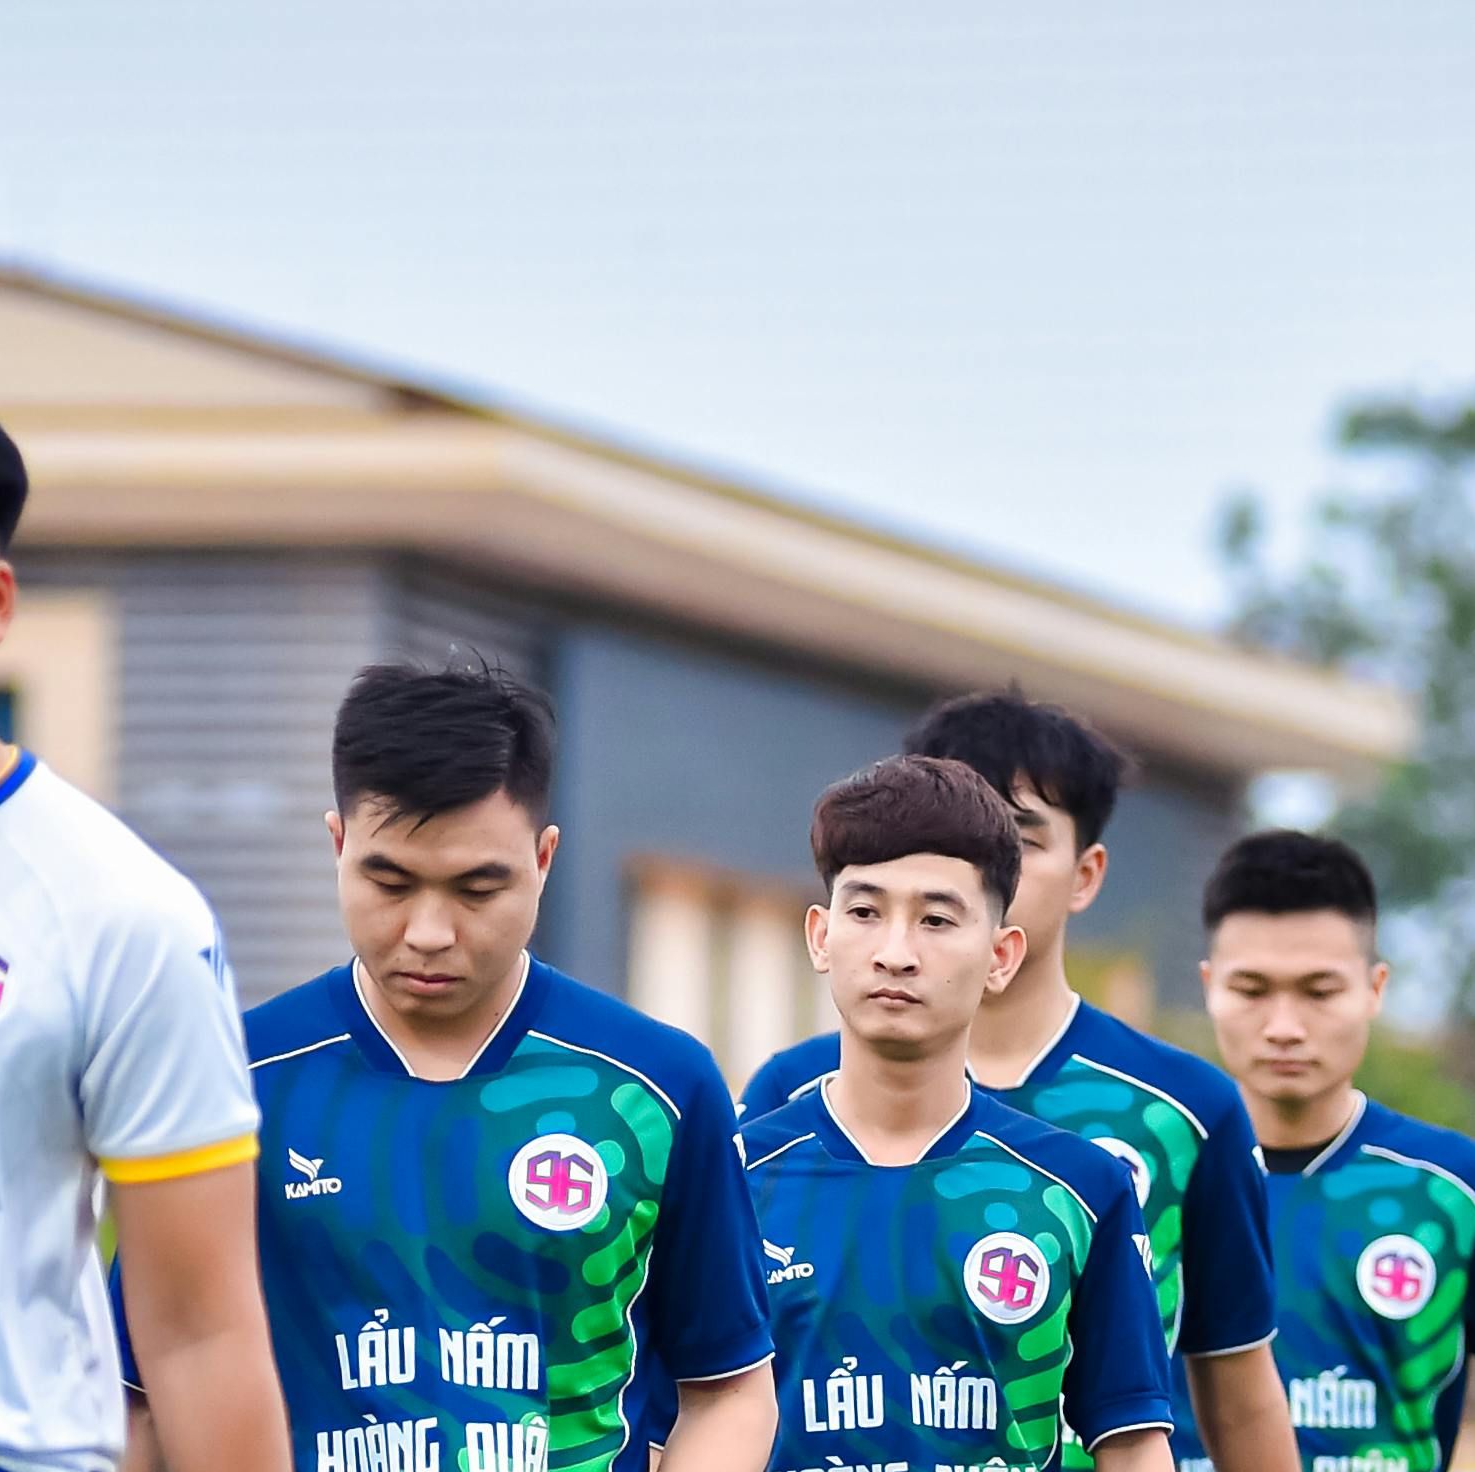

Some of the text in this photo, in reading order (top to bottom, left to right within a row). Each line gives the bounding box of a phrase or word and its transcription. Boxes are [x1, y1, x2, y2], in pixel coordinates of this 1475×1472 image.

[285, 1176, 342, 1199] KAMITO
[525, 1151, 594, 1215] 96
[766, 1263, 814, 1284] AMITO
[978, 1246, 1039, 1310] 96
[335, 1308, 540, 1391] LẨU NẤM
[802, 1357, 997, 1432] LẨU NẤM
[1289, 1364, 1377, 1429] NẤM
